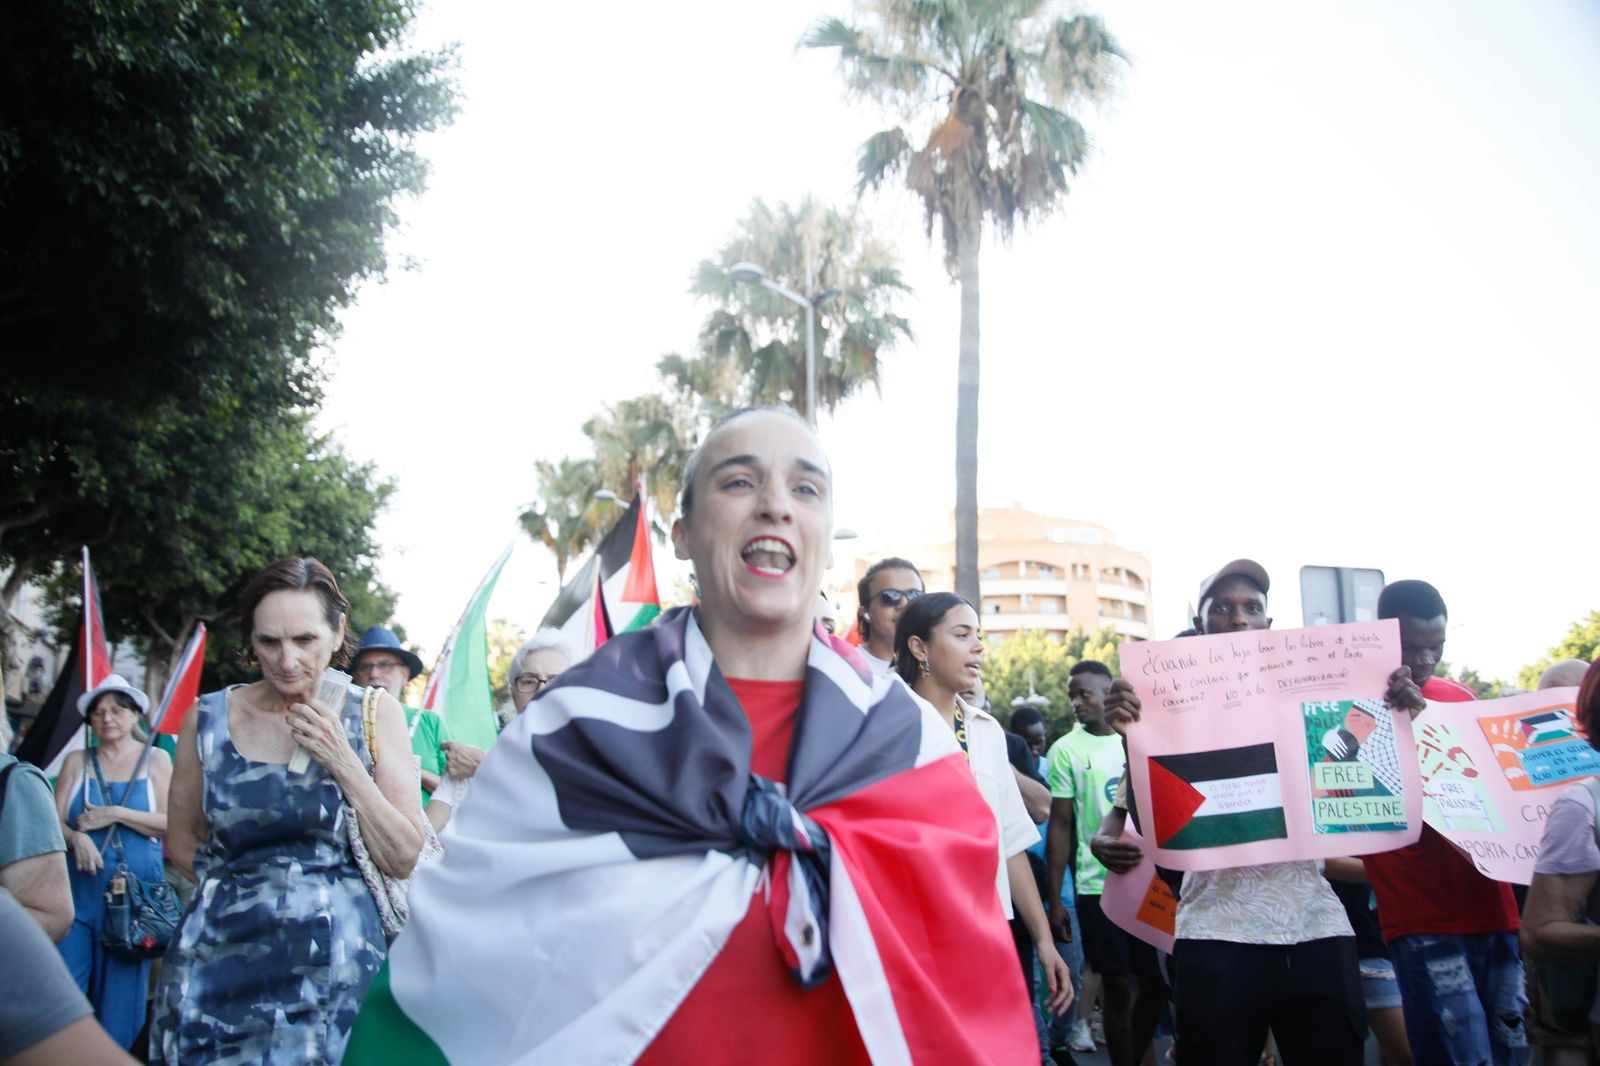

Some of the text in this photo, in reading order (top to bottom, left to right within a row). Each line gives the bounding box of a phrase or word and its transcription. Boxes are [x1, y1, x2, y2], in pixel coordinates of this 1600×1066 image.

[1226, 688, 1240, 701] NO
[1322, 765, 1366, 784] FREE
[1440, 783, 1464, 794] FREE
[1319, 801, 1404, 819] PALESTINE
[1439, 797, 1481, 810] PALESTINE
